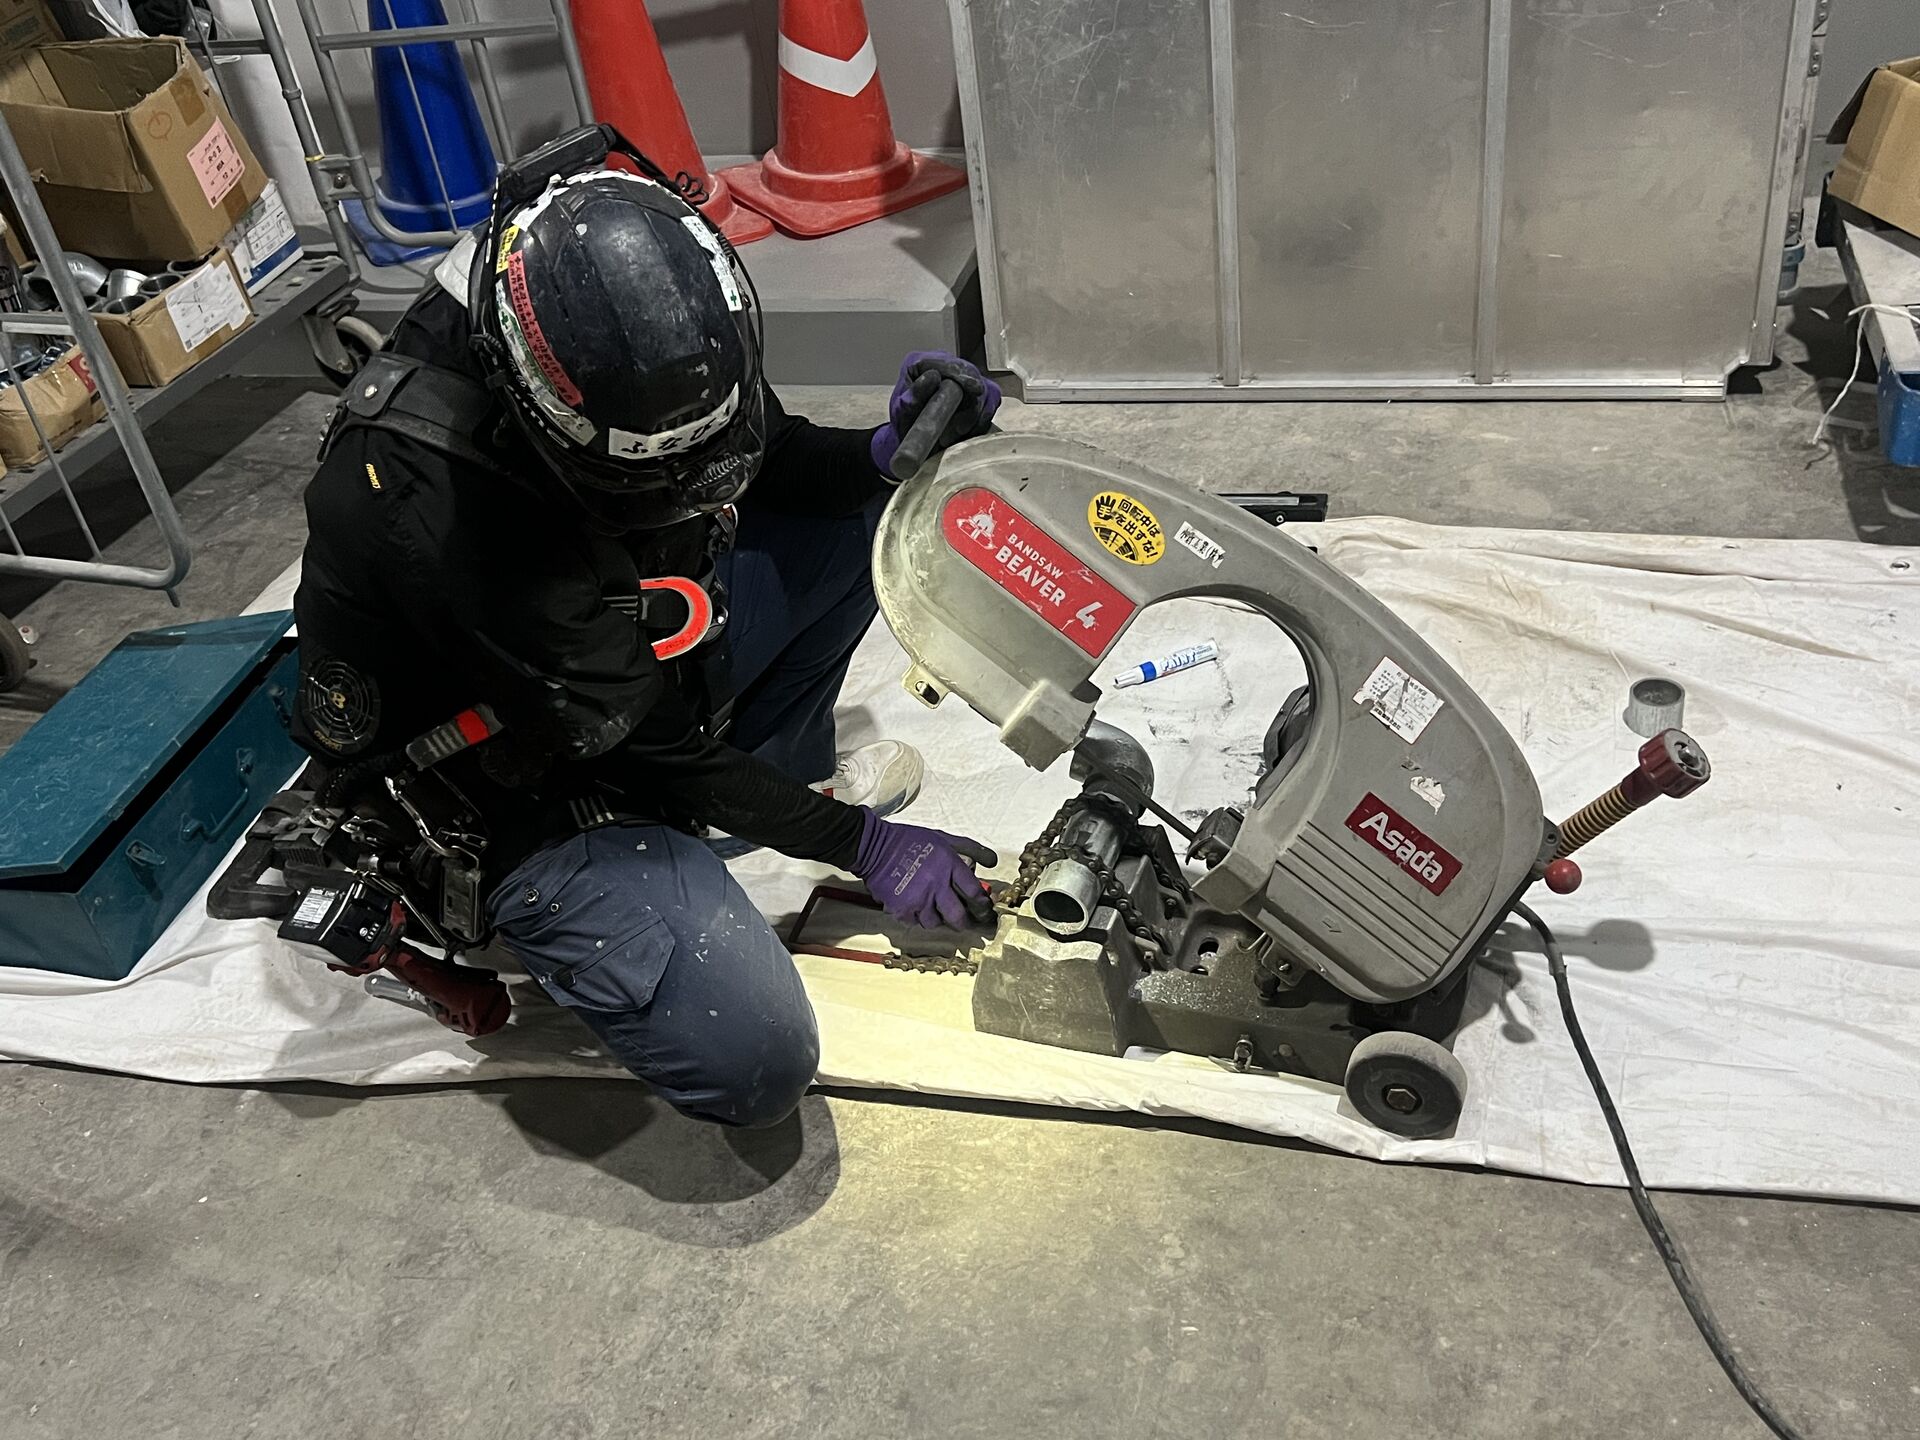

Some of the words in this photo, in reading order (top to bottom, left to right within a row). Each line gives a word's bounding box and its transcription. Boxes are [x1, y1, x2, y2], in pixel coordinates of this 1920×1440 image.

[1118, 498, 1161, 538] 回転中は
[994, 545, 1067, 607] BEAVER
[1007, 533, 1064, 580] BANDSAW
[1075, 601, 1103, 629] 4
[1358, 811, 1444, 884] Asada
